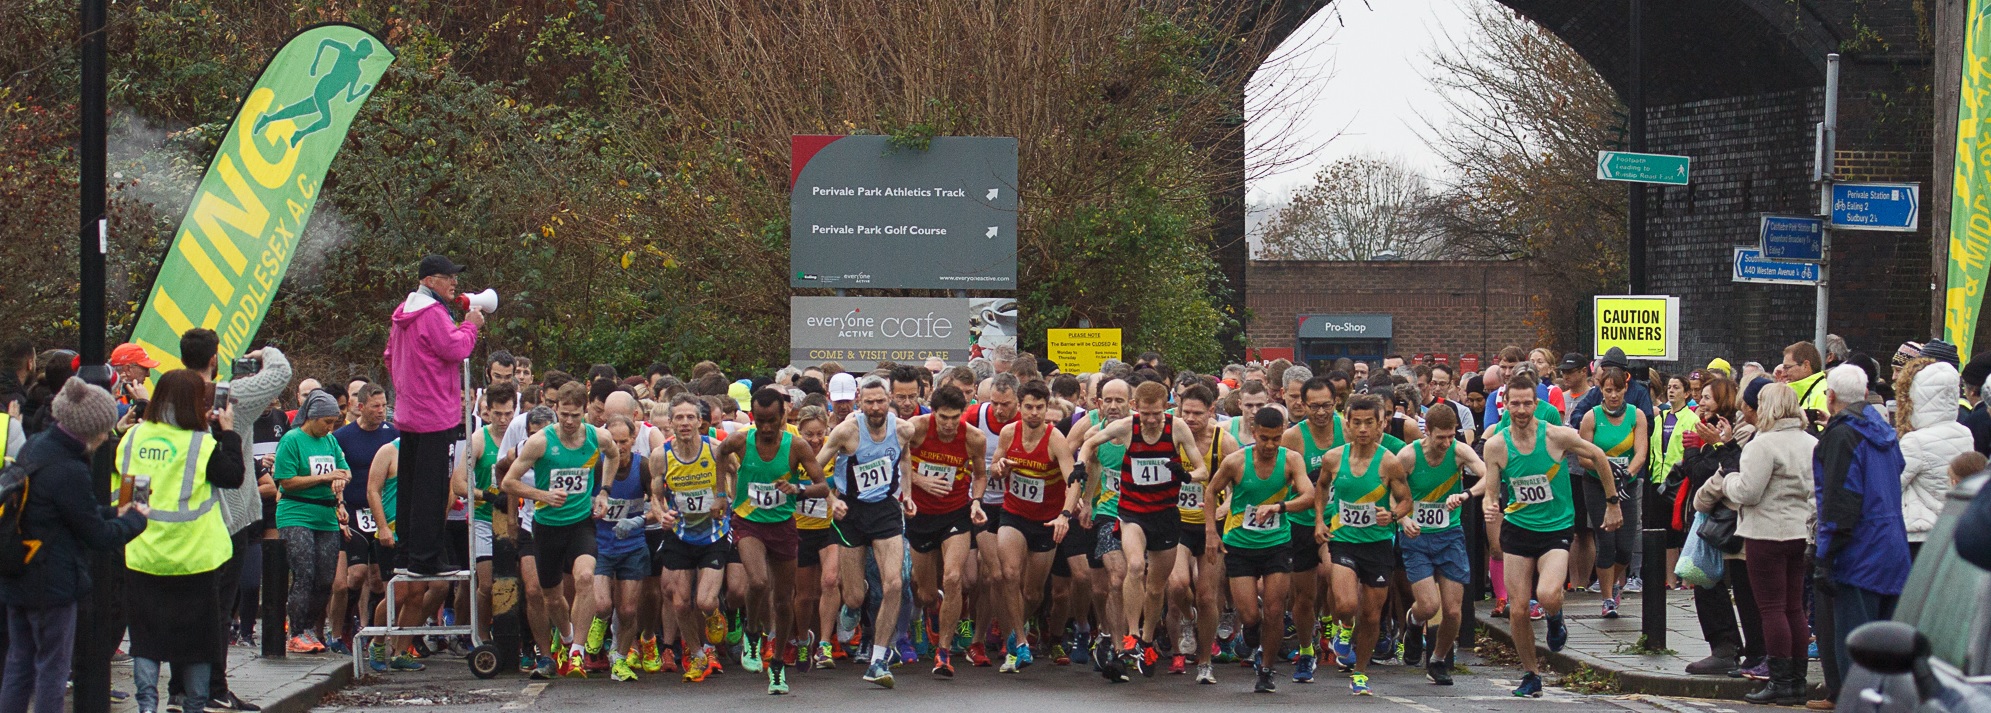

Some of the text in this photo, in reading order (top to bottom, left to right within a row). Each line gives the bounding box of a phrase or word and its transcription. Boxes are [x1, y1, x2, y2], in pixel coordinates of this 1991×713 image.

[812, 186, 965, 198] Perivale Park Athletics Track
[1847, 190, 1869, 200] Perivale
[1870, 190, 1890, 200] Station
[1846, 202, 1869, 212] Ealing 2
[1846, 212, 1868, 224] Sudbury
[812, 225, 947, 236] Perivale Park Golf Course
[843, 272, 871, 281] everyone
[1744, 266, 1756, 274] A40
[1756, 266, 1777, 276] Western
[1778, 268, 1796, 276] Avenue
[217, 217, 296, 367] MIDDLESEX
[806, 310, 874, 329] everyone
[1603, 310, 1660, 324] CAUTION
[880, 312, 953, 338] cafe
[1325, 322, 1367, 334] Pro-Shop
[1601, 326, 1662, 340] RUNNERS
[809, 350, 949, 361] COME & VISIT OUR CAFE
[138, 446, 169, 461] emr
[920, 450, 964, 464] SERPENTINE
[672, 472, 712, 482] Headington
[860, 466, 888, 488] 291
[1141, 466, 1158, 482] 41
[554, 476, 583, 491] 393
[1512, 478, 1540, 486] PERIVALE
[1012, 480, 1038, 500] 319
[1520, 486, 1546, 502] 500
[686, 496, 704, 511] 87
[756, 490, 780, 506] 161
[1343, 508, 1370, 524] 326
[1416, 508, 1444, 525] 380
